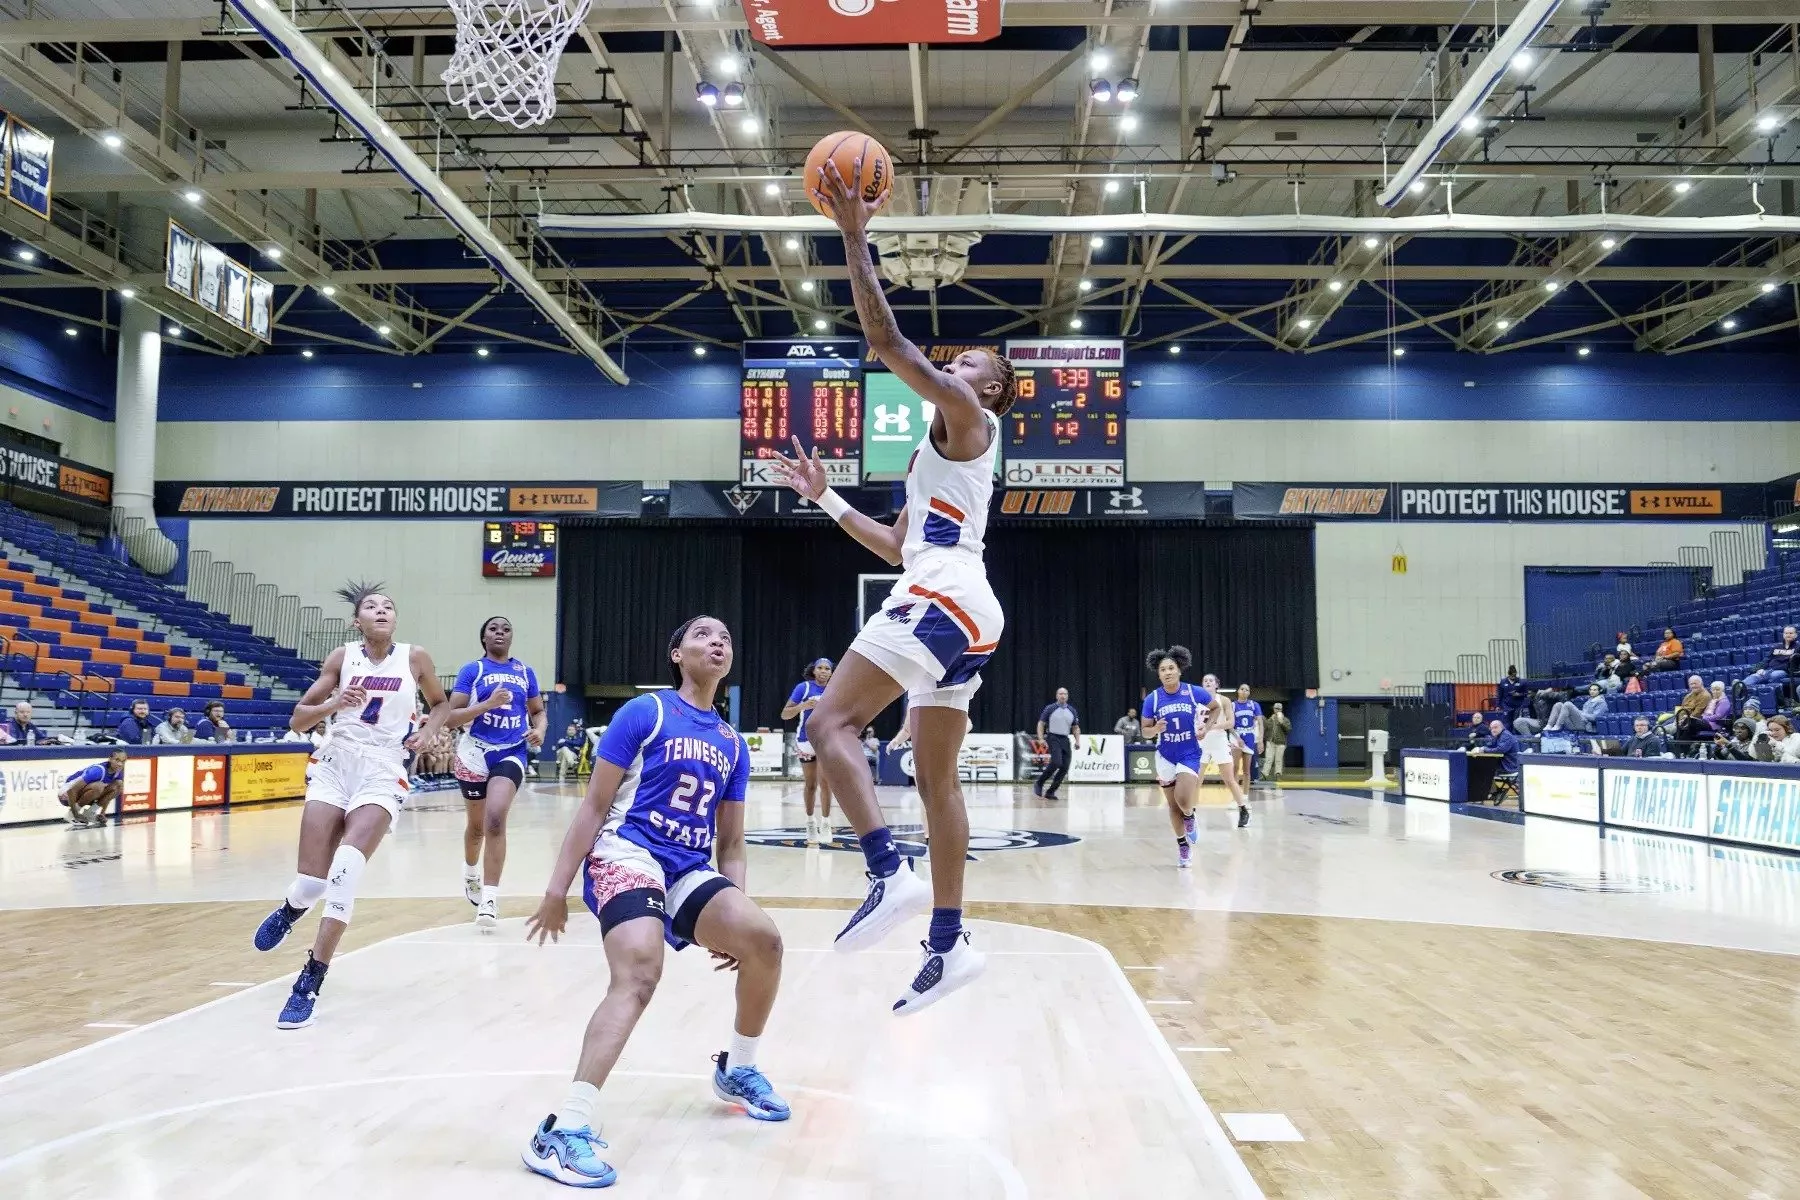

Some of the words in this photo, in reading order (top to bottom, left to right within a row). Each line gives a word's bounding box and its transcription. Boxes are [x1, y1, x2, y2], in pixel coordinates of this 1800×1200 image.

[754, 9, 784, 41] Agent
[787, 345, 817, 357] ATA
[1052, 368, 1089, 388] 7:39
[1104, 380, 1122, 398] 16
[1076, 393, 1087, 408] 2
[1107, 422, 1118, 436] 0
[1036, 465, 1122, 475] LINEN
[178, 487, 280, 512] SKYHAWKS
[292, 487, 385, 512] PROTECT
[388, 487, 425, 512] THIS
[543, 494, 550, 506] I
[1000, 489, 1077, 515] UTM
[1279, 488, 1388, 515] SKYHAWKS
[1401, 488, 1500, 515] PROTECT
[1502, 488, 1543, 515] THIS
[1664, 497, 1671, 508] I
[360, 696, 384, 725] 4
[1158, 703, 1192, 718] TENNESSEE
[1171, 717, 1180, 730] 1
[1163, 733, 1192, 742] STATE
[1075, 760, 1120, 771] Nutrien
[11, 771, 48, 793] West
[670, 773, 716, 817] 22
[1611, 775, 1631, 820] UT
[1632, 776, 1699, 829] MARTIN
